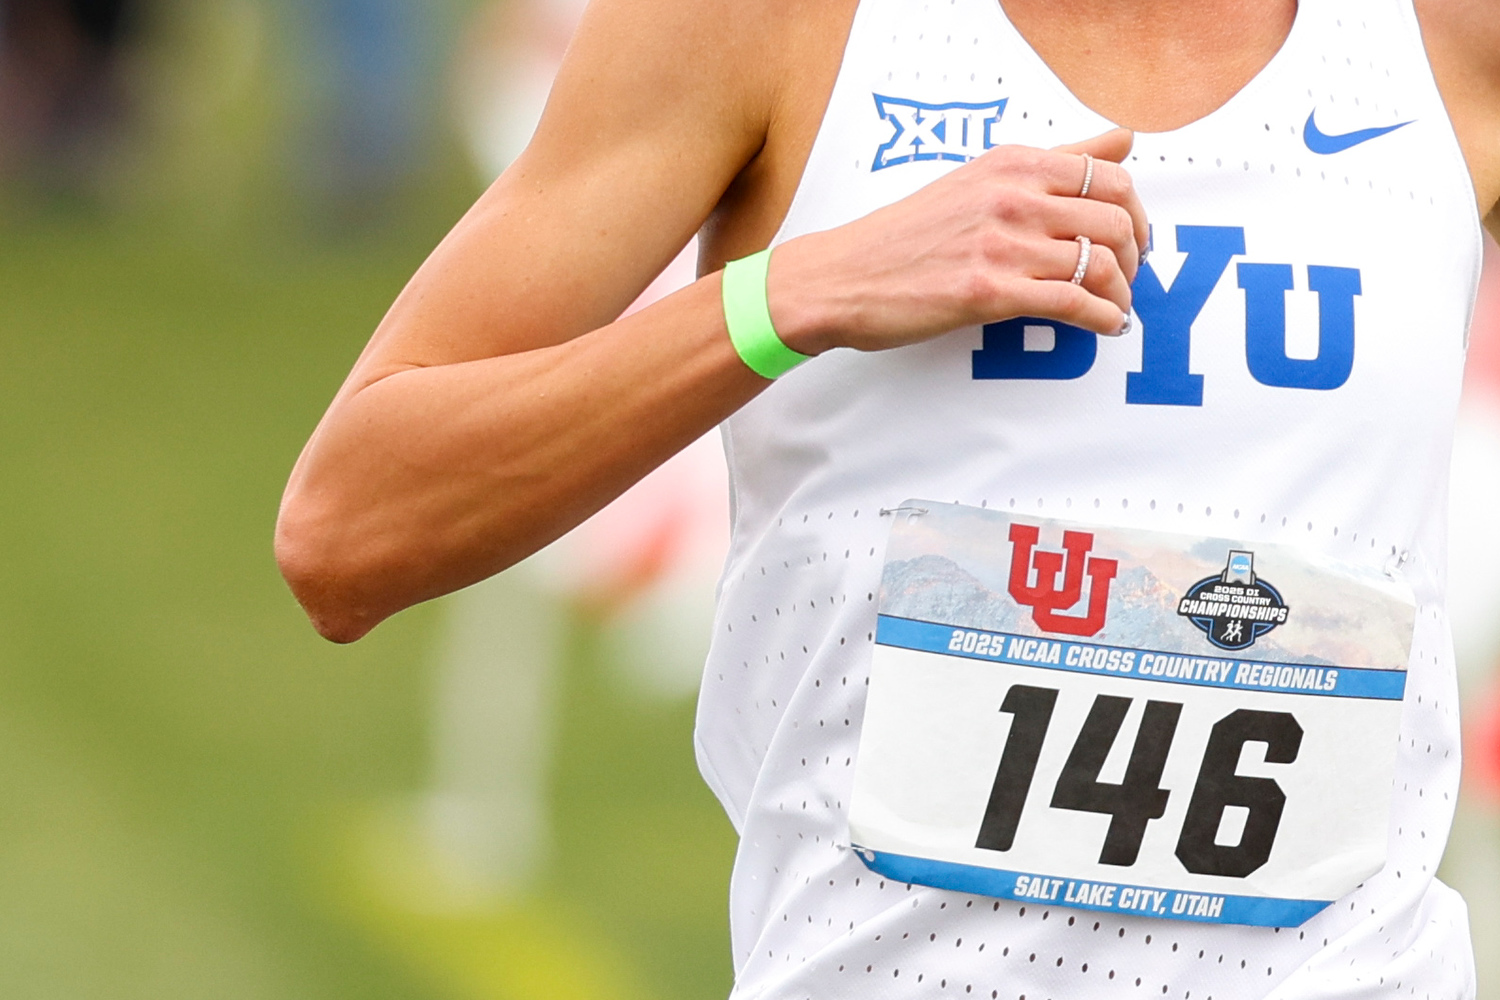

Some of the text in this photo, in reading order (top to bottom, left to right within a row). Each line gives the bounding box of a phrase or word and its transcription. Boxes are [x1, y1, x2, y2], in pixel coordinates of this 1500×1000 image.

[1199, 592, 1272, 606] CROSS COUNTRY
[1213, 585, 1244, 595] 2025
[1180, 599, 1287, 622] CHAMPIONSHIPS
[948, 630, 1339, 691] 2025 NCAA CROSS COUNTRY REGIONALS
[974, 683, 1305, 879] 146
[1013, 875, 1225, 918] SALT LAKE CITY, UTAH
